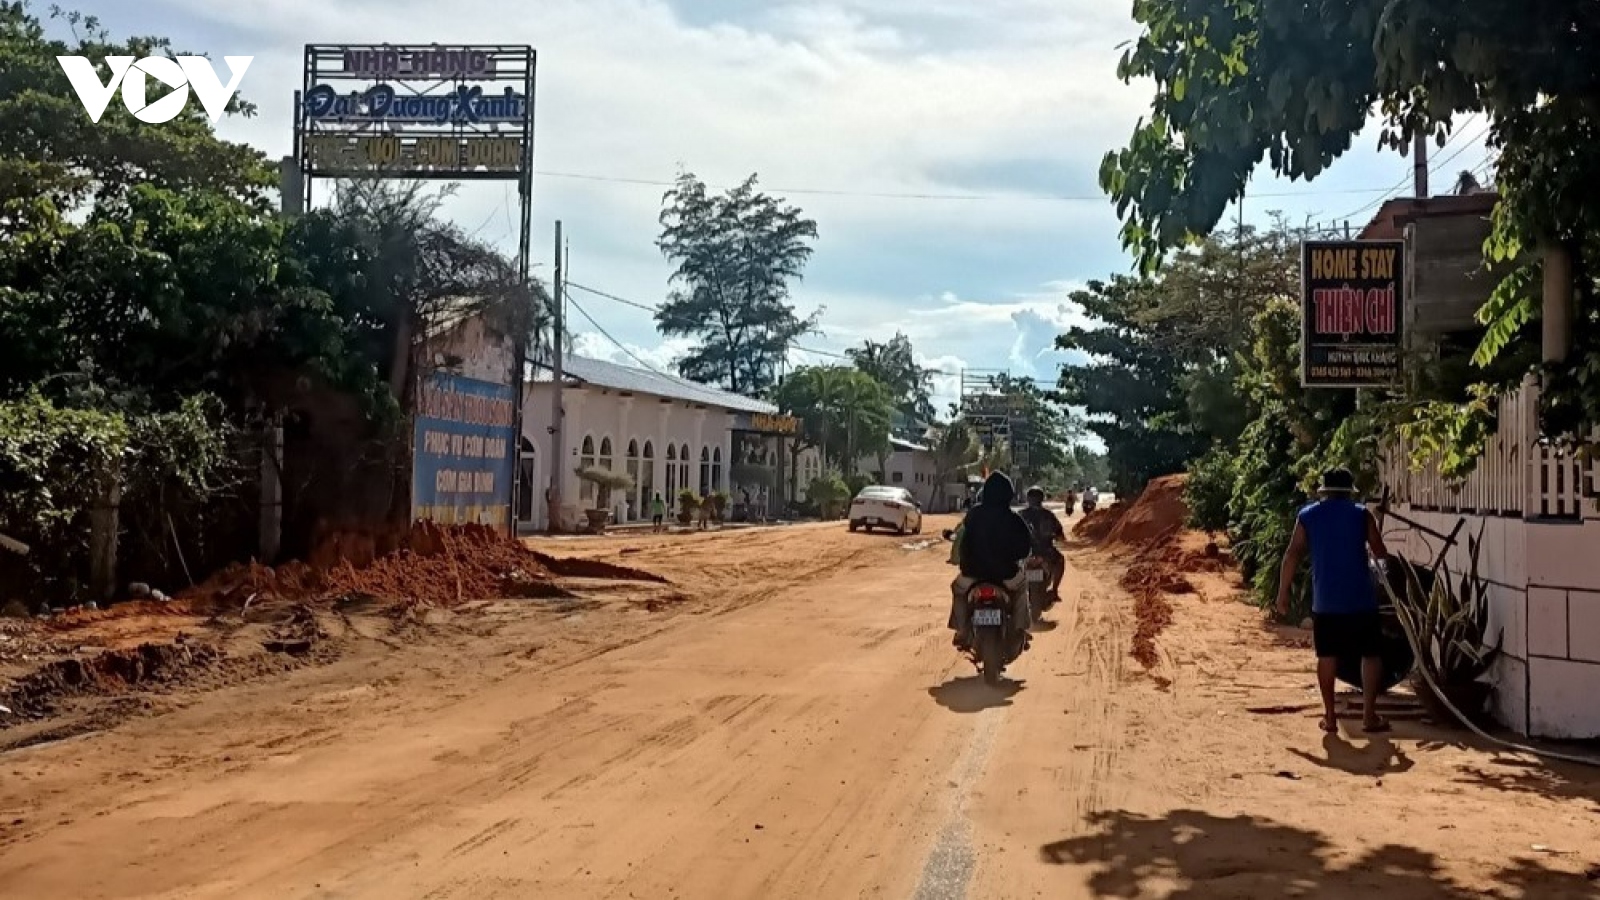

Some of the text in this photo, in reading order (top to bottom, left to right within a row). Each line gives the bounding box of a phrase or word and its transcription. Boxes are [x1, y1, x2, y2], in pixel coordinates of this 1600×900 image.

[456, 85, 520, 124] Xanh
[1311, 249, 1395, 279] HOME STAY
[1313, 282, 1364, 342] THIỆN
